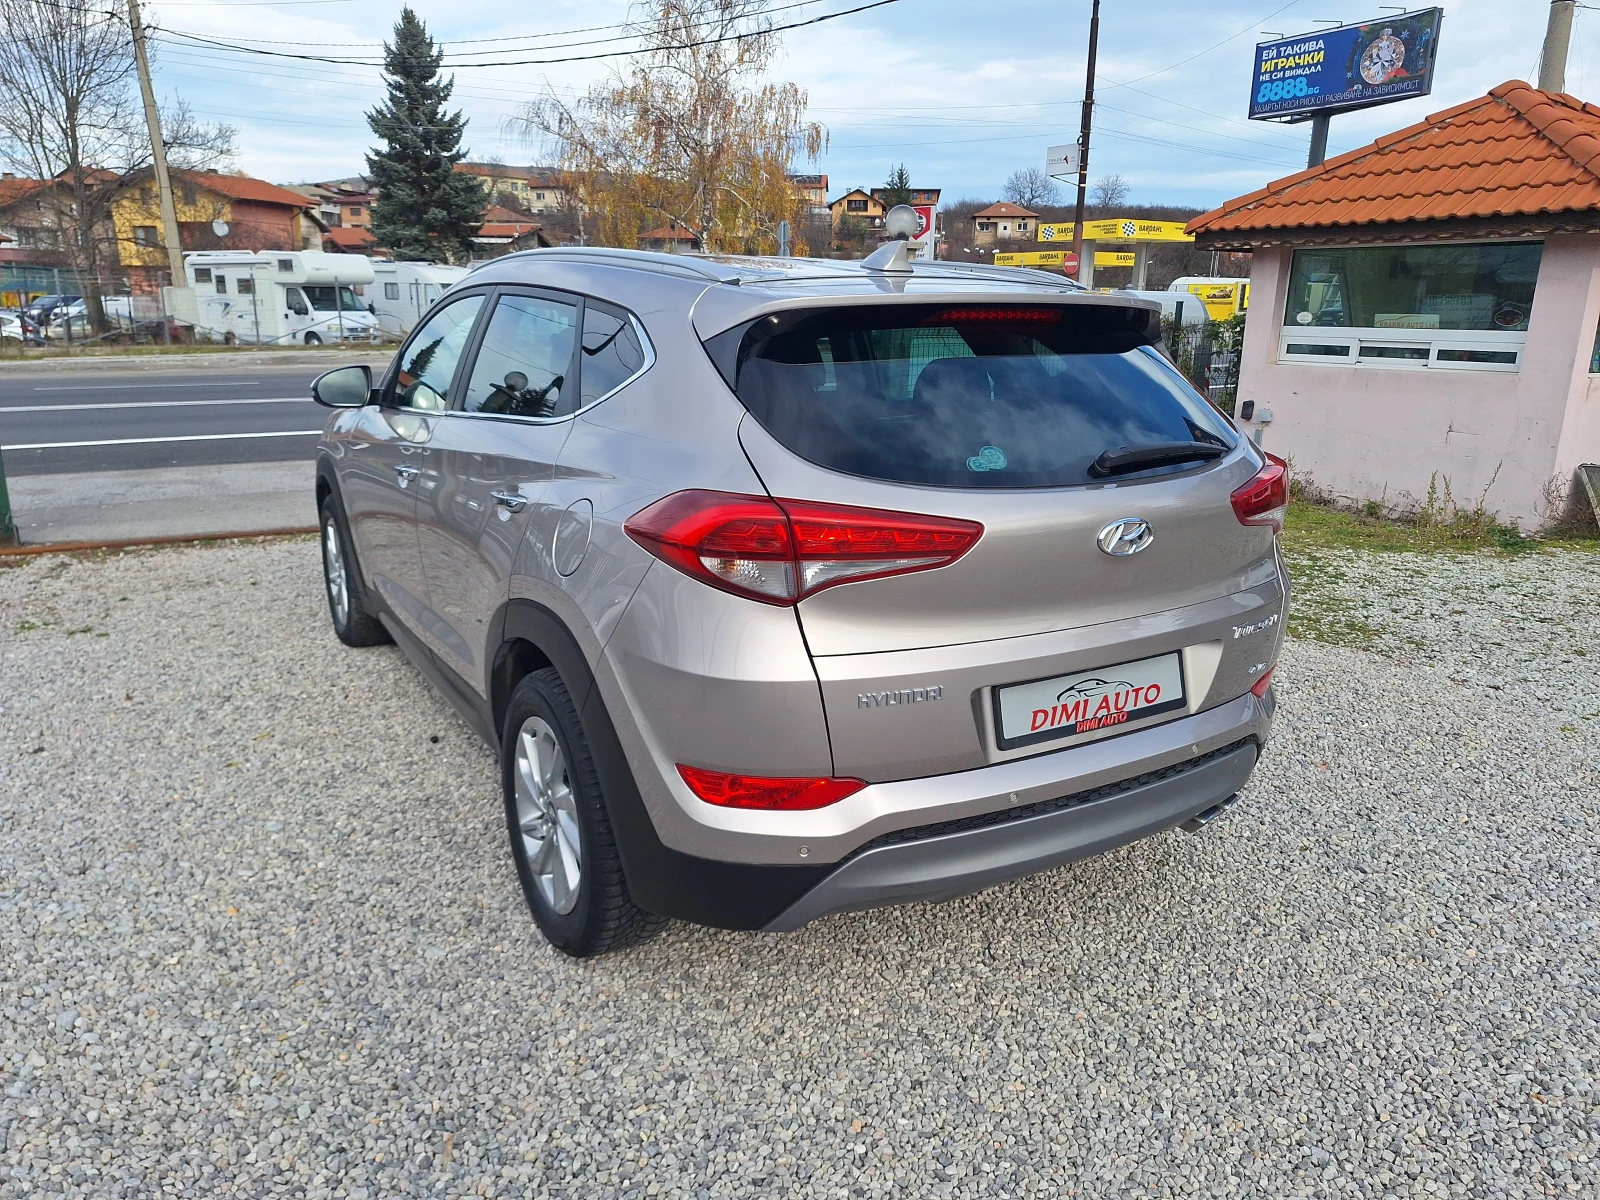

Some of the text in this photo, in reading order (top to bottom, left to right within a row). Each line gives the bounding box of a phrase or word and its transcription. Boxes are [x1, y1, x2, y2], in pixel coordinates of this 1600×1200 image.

[1262, 39, 1325, 60] ЕЙ ТАКИВА
[1261, 50, 1325, 73] ИГРАЧКИ
[1260, 65, 1322, 82] НЕ СИ ВИЖДАЛ
[1254, 101, 1283, 114] ХАЗАРТЪТ
[1283, 99, 1299, 109] НОСИ
[1300, 97, 1316, 107] РИСК
[1316, 94, 1325, 104] ОТ
[1363, 88, 1372, 97] НА
[1372, 79, 1420, 95] ЗАВИСИМОСТ
[1057, 227, 1074, 236] BARDA
[1139, 225, 1163, 235] BARDAHL
[1039, 253, 1060, 262] BARDAHL
[1406, 321, 1424, 329] AUTO
[857, 685, 944, 709] HYUNDAI
[1030, 683, 1161, 732] DIMI AUTO
[1075, 710, 1128, 733] DIMI AUTO
